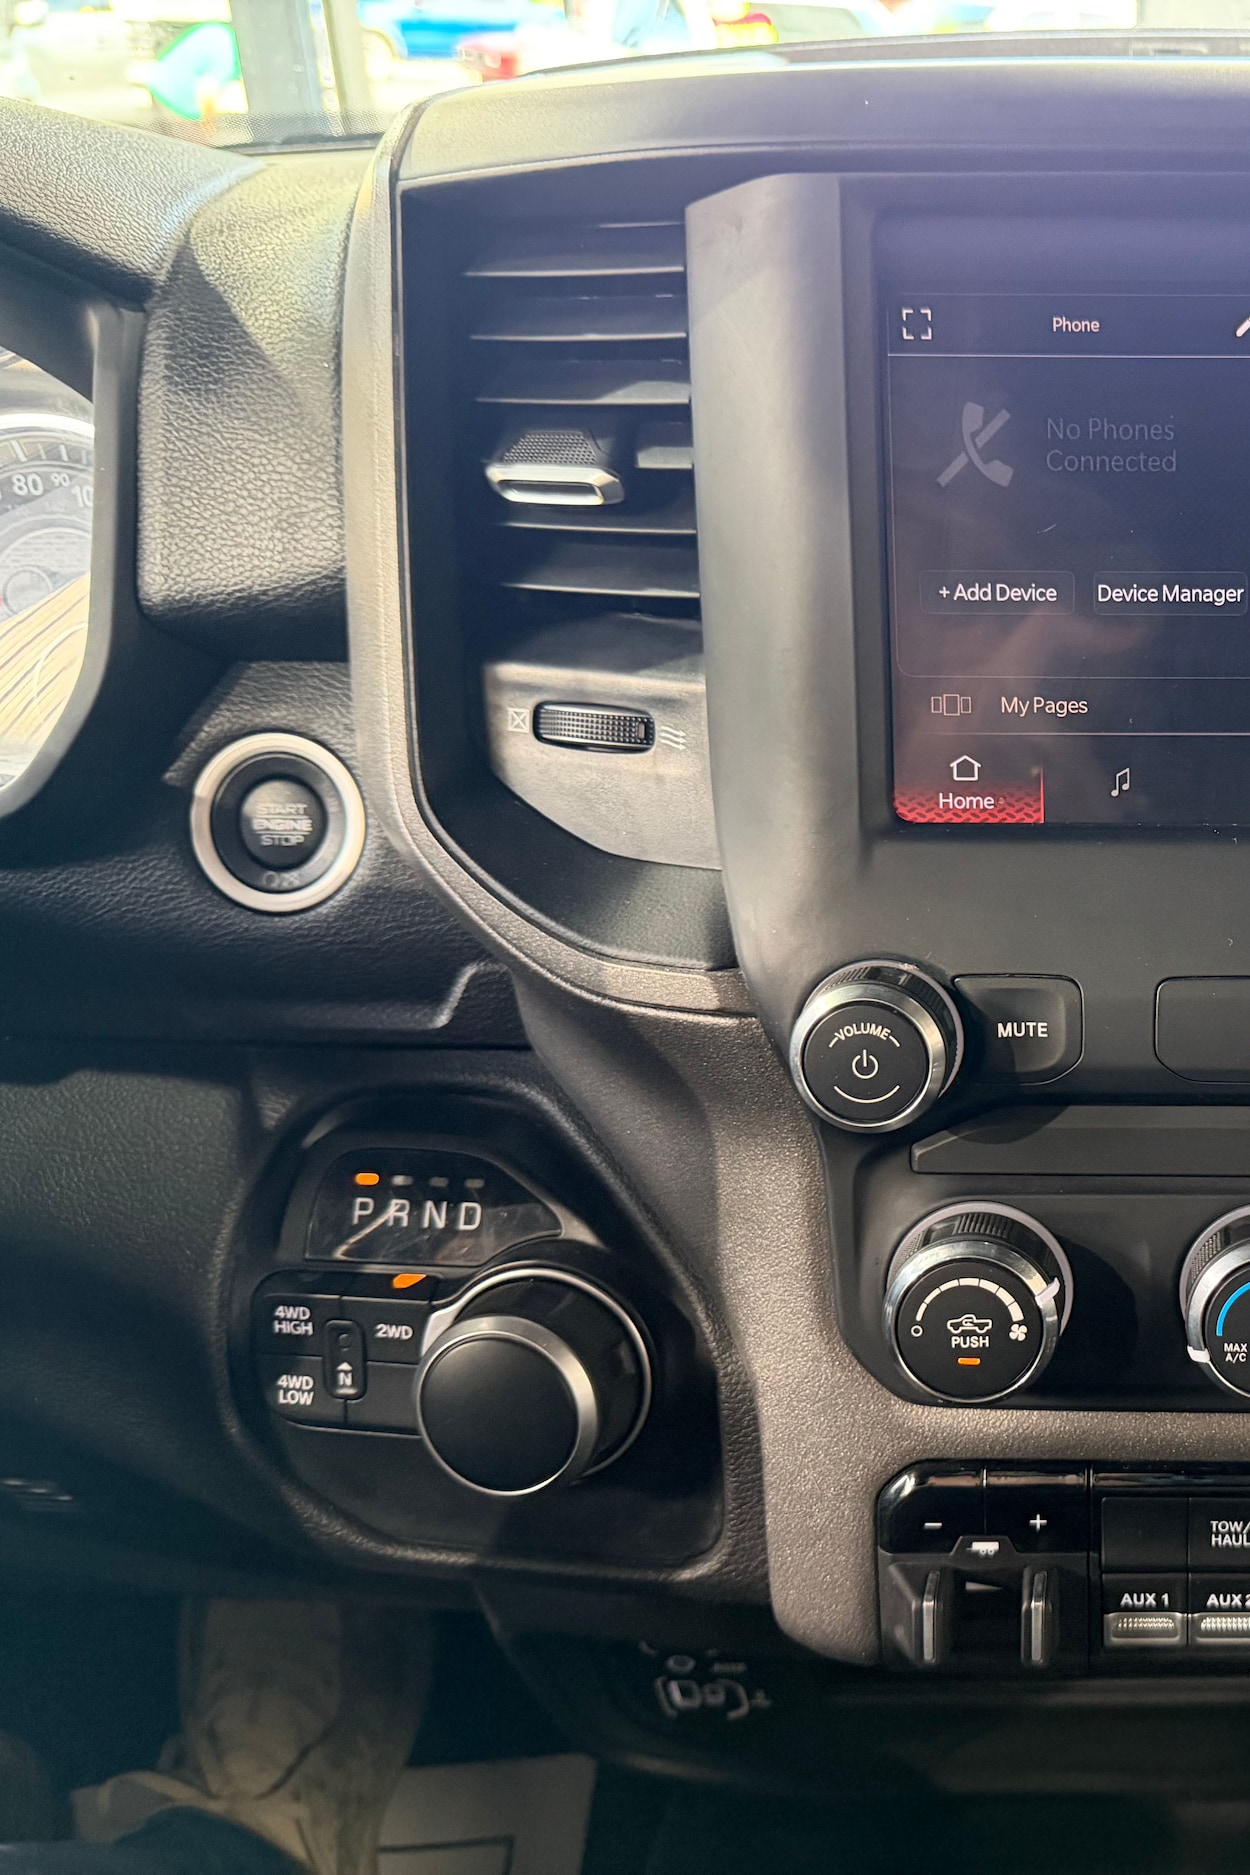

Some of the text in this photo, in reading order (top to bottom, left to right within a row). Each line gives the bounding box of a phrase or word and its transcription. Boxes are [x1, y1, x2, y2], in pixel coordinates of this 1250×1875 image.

[1052, 316, 1100, 333] Phone
[1046, 417, 1175, 441] No Phones
[1045, 450, 1177, 473] Connected
[11, 473, 43, 496] 80
[50, 472, 70, 487] 90
[996, 583, 1057, 601] Device
[1098, 584, 1244, 606] Device Manager
[1001, 696, 1088, 718] My Pages
[258, 804, 308, 815] START
[938, 793, 995, 810] Home
[252, 819, 313, 831] ENGINE
[262, 835, 305, 846] STOP
[834, 1022, 892, 1041] VOLUME
[997, 1022, 1049, 1038] MUTE
[353, 1197, 375, 1225] P
[423, 1201, 447, 1230] N
[458, 1202, 482, 1231] D
[274, 1305, 311, 1320] 4WD
[273, 1320, 313, 1336] HIGH
[374, 1324, 413, 1340] 2WD
[951, 1336, 989, 1349] PUSH
[1223, 1343, 1248, 1353] MAX
[1225, 1353, 1247, 1364] A/C
[277, 1375, 314, 1390] 4WD
[338, 1372, 353, 1386] N
[278, 1390, 314, 1406] LOW
[1120, 1593, 1170, 1607] AUX 1
[1207, 1593, 1243, 1607] AUX
